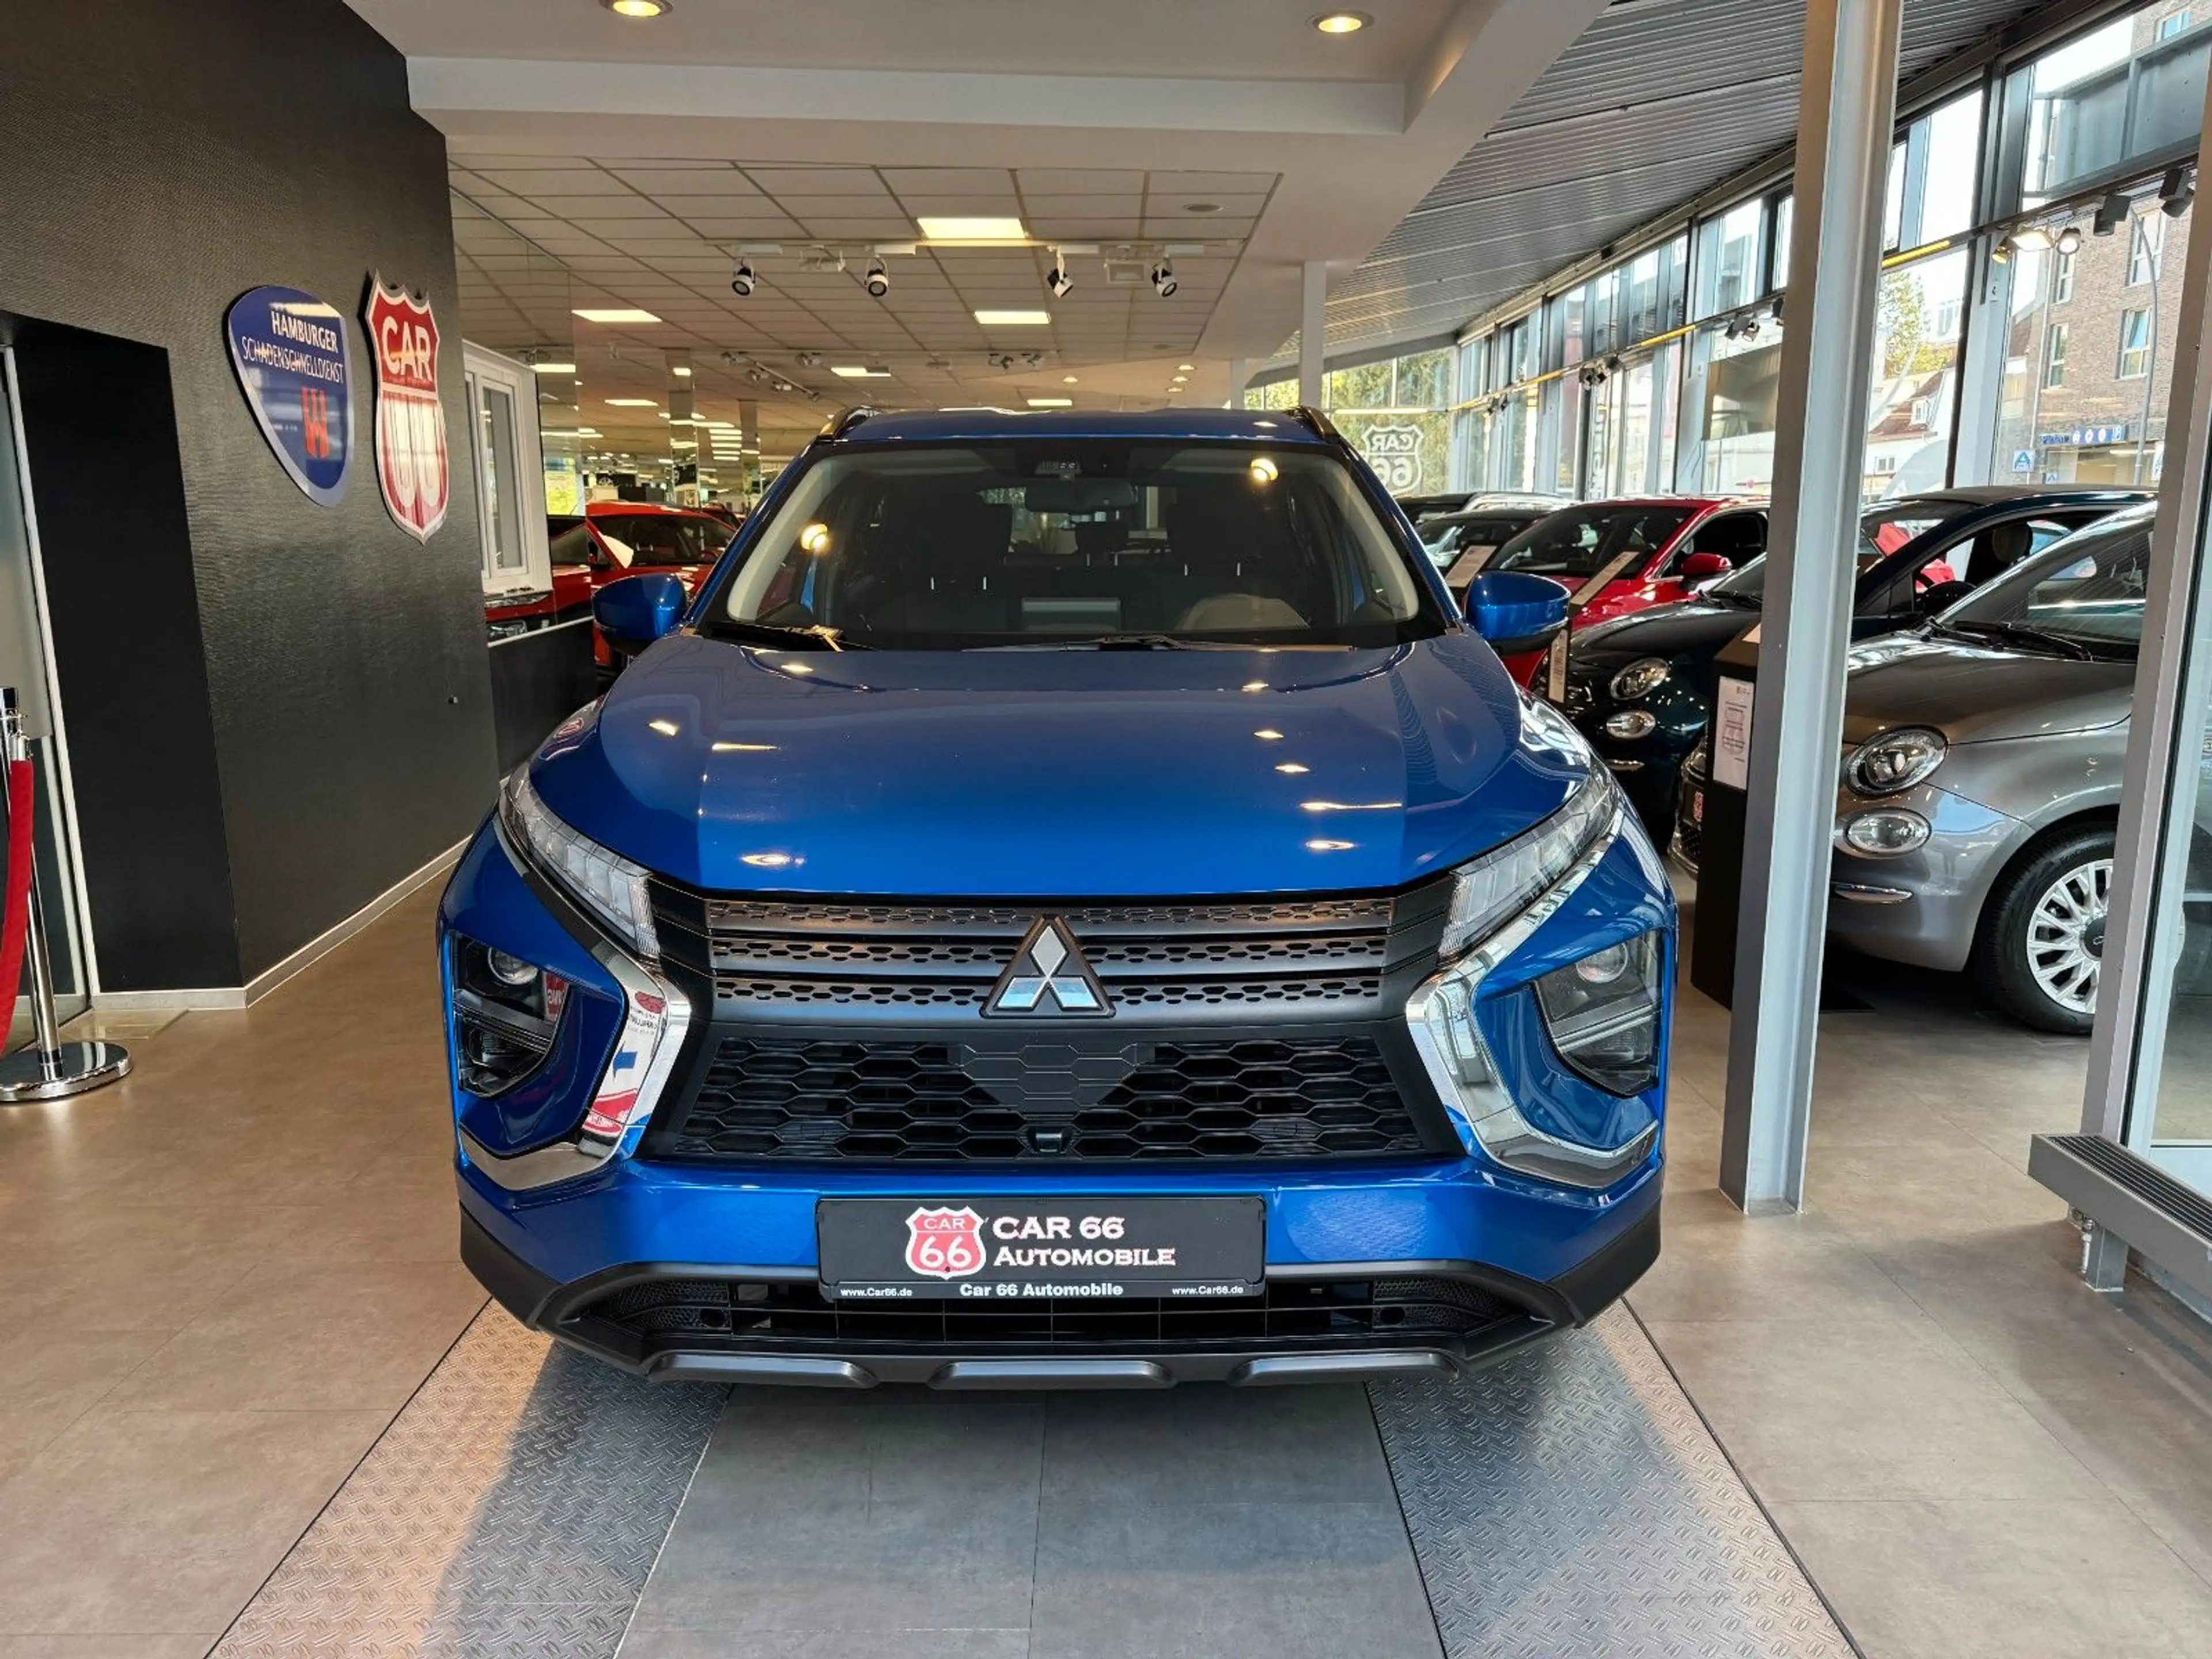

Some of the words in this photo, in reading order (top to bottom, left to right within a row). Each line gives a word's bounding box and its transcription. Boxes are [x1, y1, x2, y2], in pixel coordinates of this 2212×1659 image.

[271, 311, 339, 353] HAMBURGER
[381, 316, 433, 381] CAR
[923, 1218, 966, 1230] CAR
[993, 1216, 1072, 1239] CAR
[1079, 1216, 1125, 1239] 66
[919, 1235, 972, 1268] 66
[993, 1245, 1176, 1266] AUTOMOBILE
[840, 1287, 912, 1296] www.Car66.de
[960, 1283, 991, 1296] Car
[995, 1283, 1018, 1296] 66
[1022, 1283, 1123, 1296] Automobile
[1172, 1286, 1244, 1295] www.Car66.de
